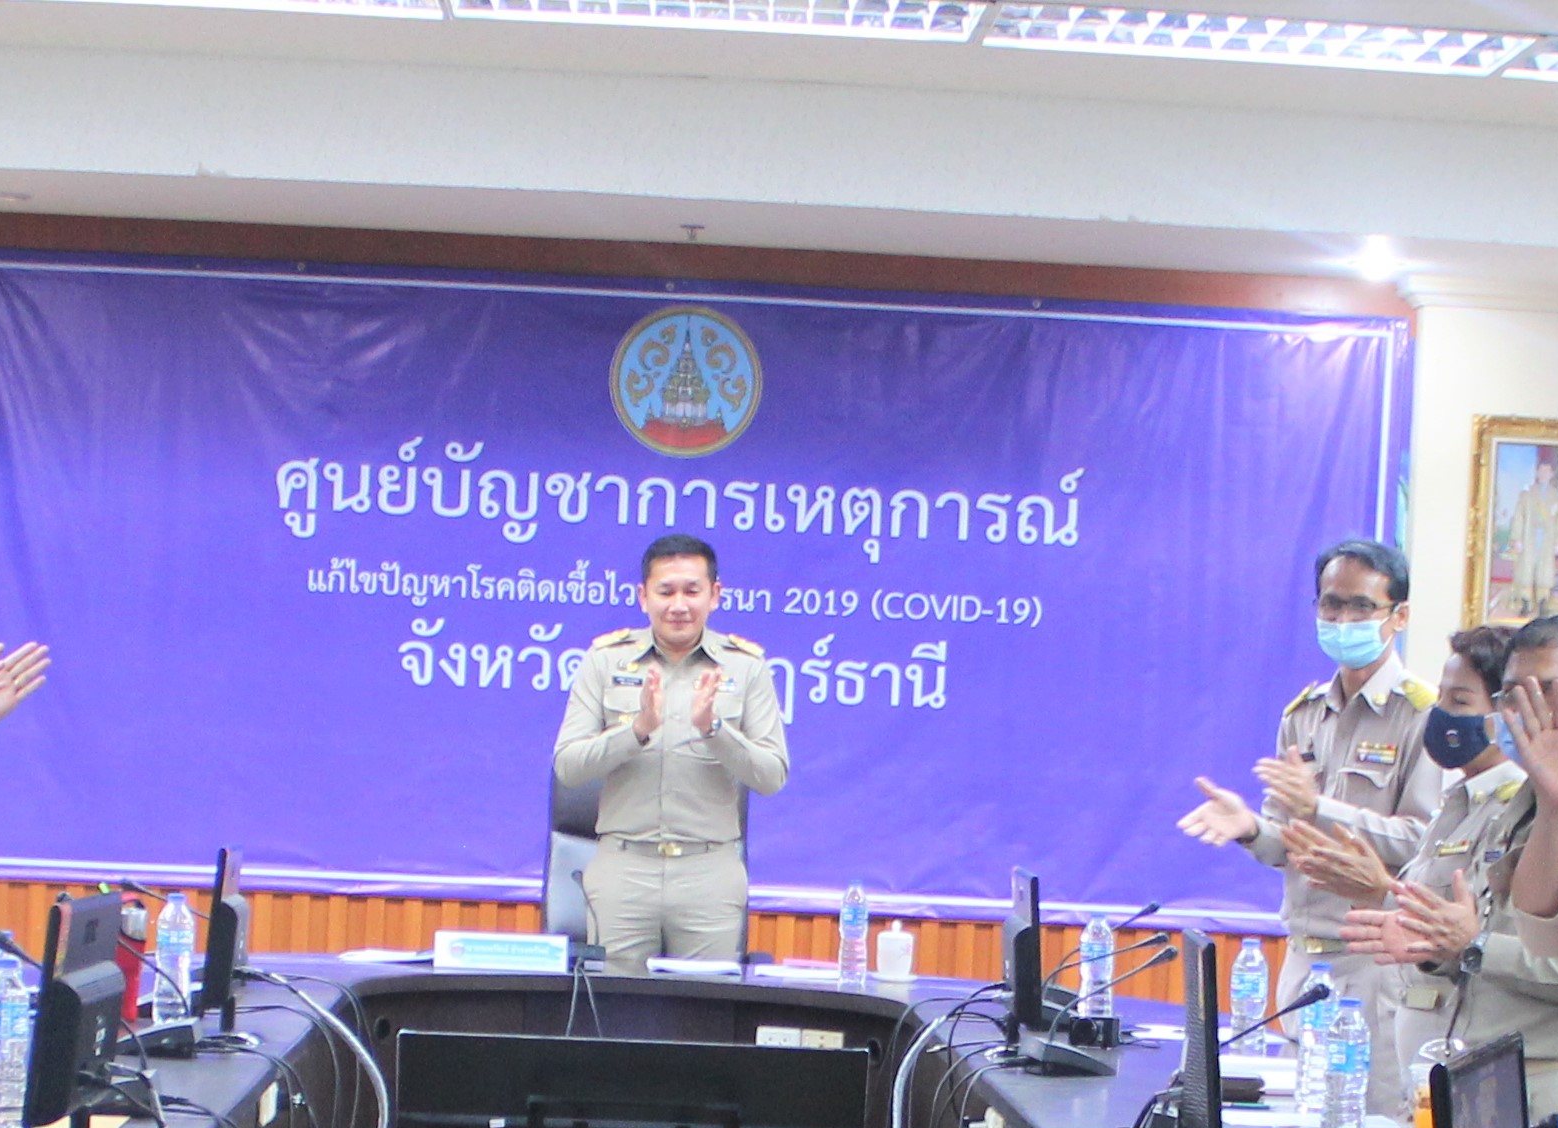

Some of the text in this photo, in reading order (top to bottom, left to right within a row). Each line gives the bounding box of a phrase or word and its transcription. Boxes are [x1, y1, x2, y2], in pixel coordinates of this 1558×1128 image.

[276, 437, 1084, 564] ศูนย์บัญชาการเหตุการณ์
[783, 587, 859, 617] 2019
[871, 588, 1043, 628] (COVID-19)
